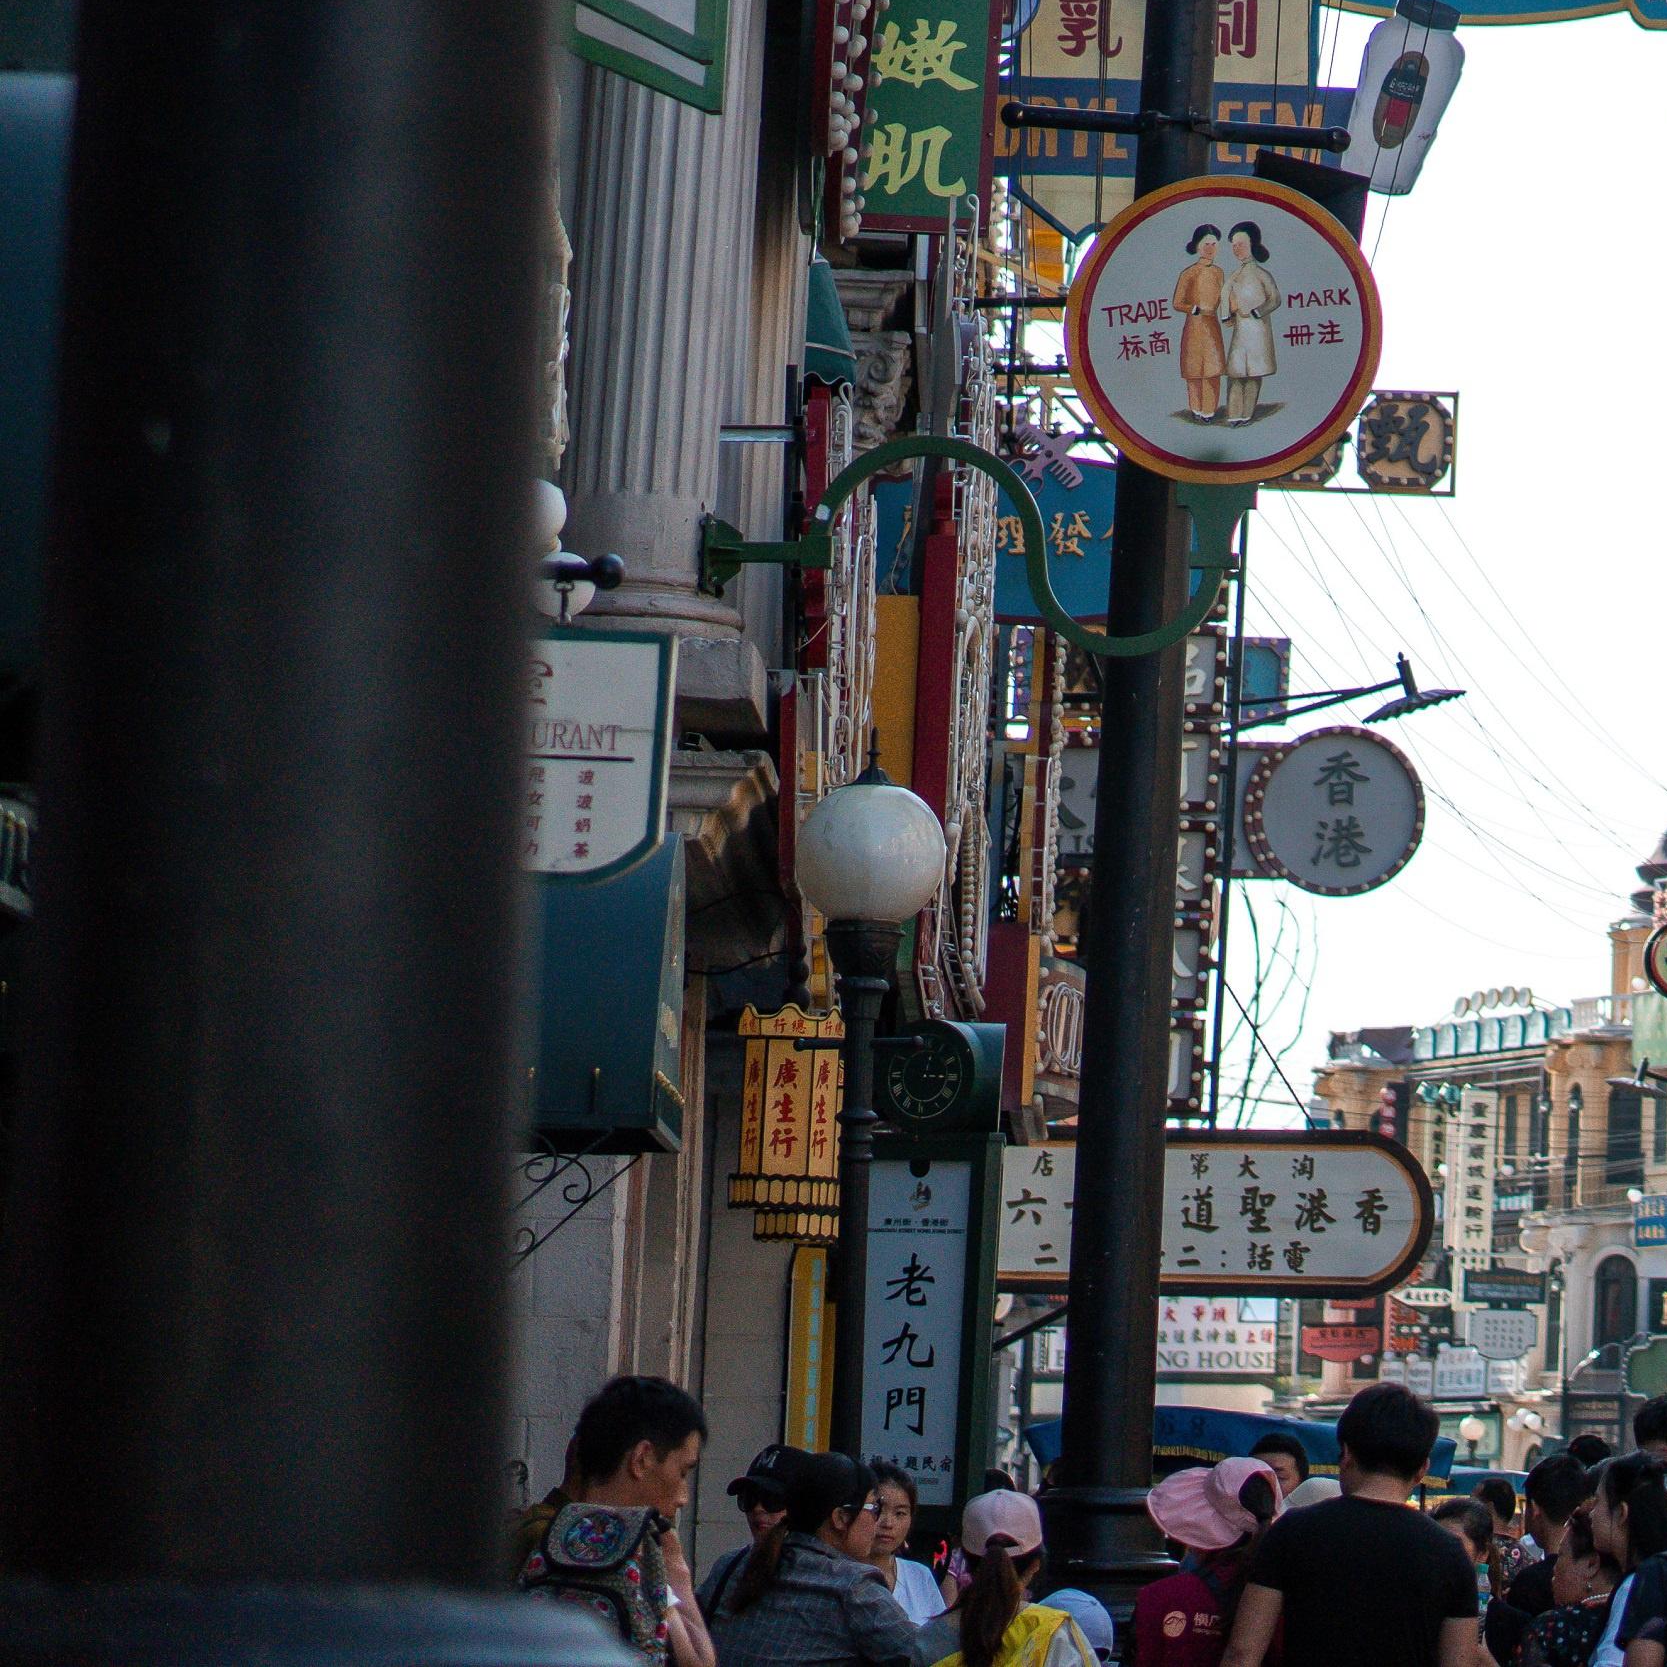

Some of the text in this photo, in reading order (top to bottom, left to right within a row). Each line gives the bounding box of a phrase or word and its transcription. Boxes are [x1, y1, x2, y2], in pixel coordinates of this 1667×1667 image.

[1102, 298, 1172, 328] TRADE
[1287, 288, 1352, 309] MARK
[1311, 749, 1372, 869] 香港
[769, 1058, 799, 1159] 廣生行
[811, 1059, 831, 1159] 廣生行
[882, 1252, 935, 1436] 老九門
